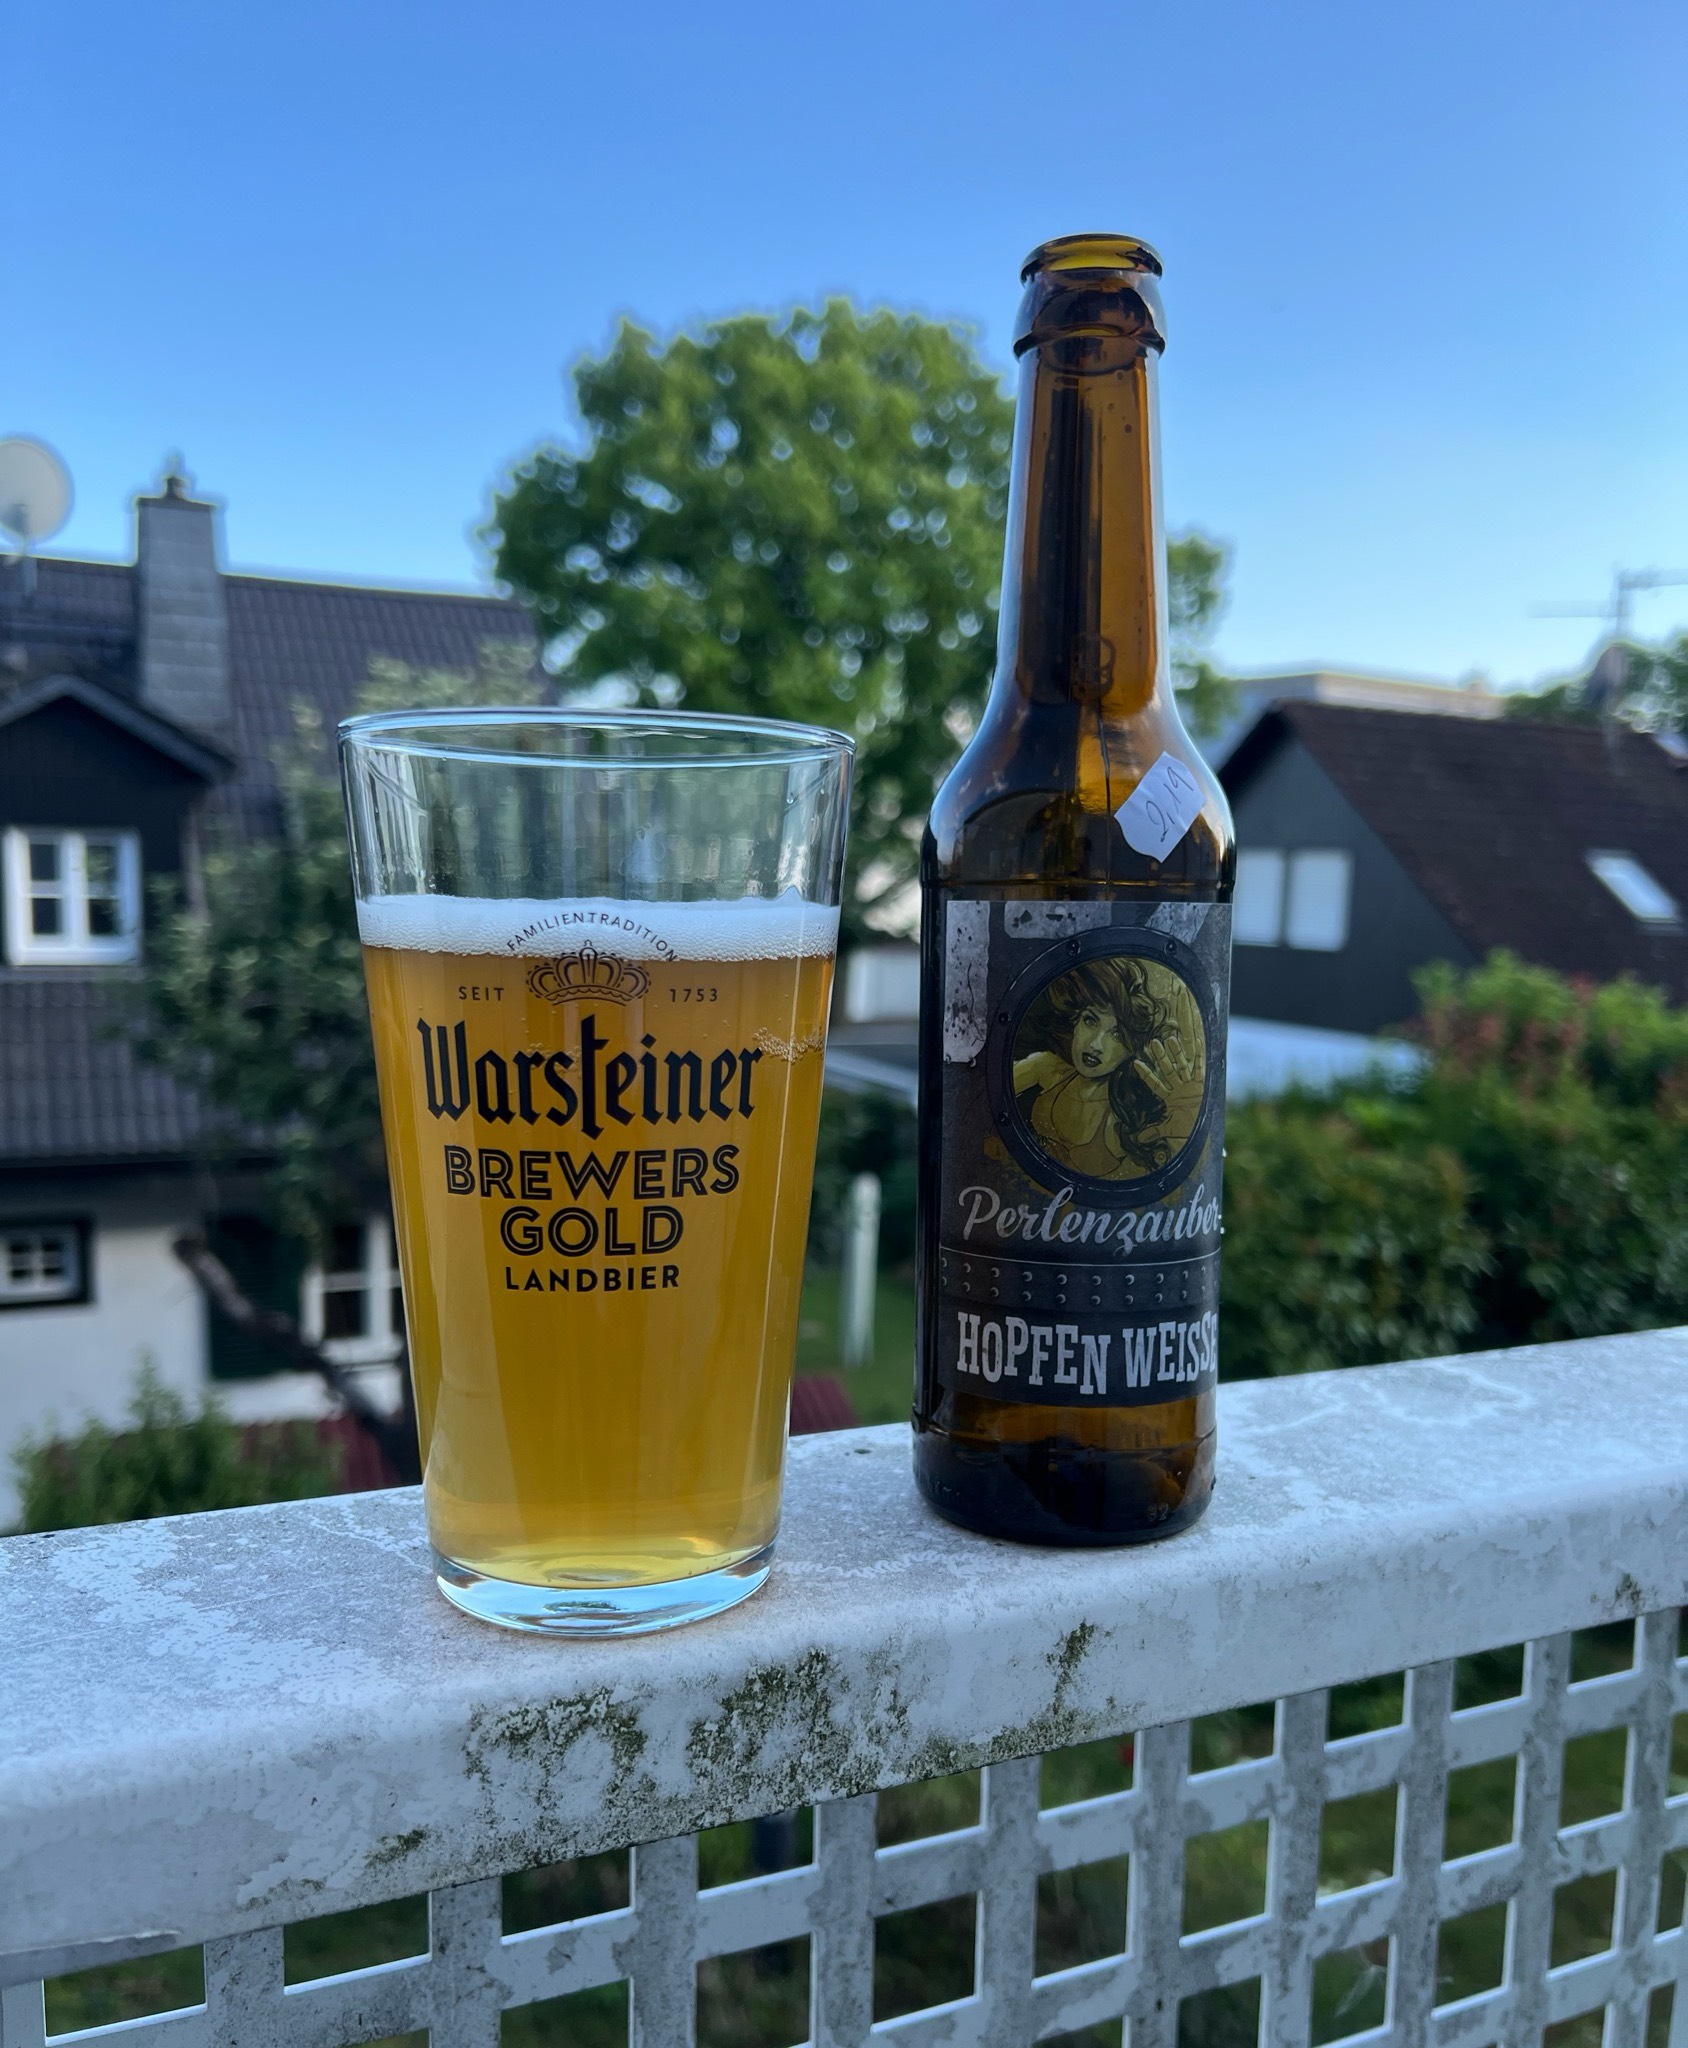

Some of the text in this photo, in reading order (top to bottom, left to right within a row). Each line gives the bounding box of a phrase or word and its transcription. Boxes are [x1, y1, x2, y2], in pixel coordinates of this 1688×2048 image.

[506, 912, 678, 962] FAMILIENTRADITION
[458, 986, 719, 1003] SEIT 1753
[417, 1014, 763, 1140] Warsteiner
[444, 1144, 740, 1200] BREWERS
[500, 1205, 684, 1257] GOLD
[958, 1184, 1220, 1255] Perlenzauber
[505, 1264, 680, 1292] LANDBIER
[957, 1311, 1111, 1395] HOPFEN
